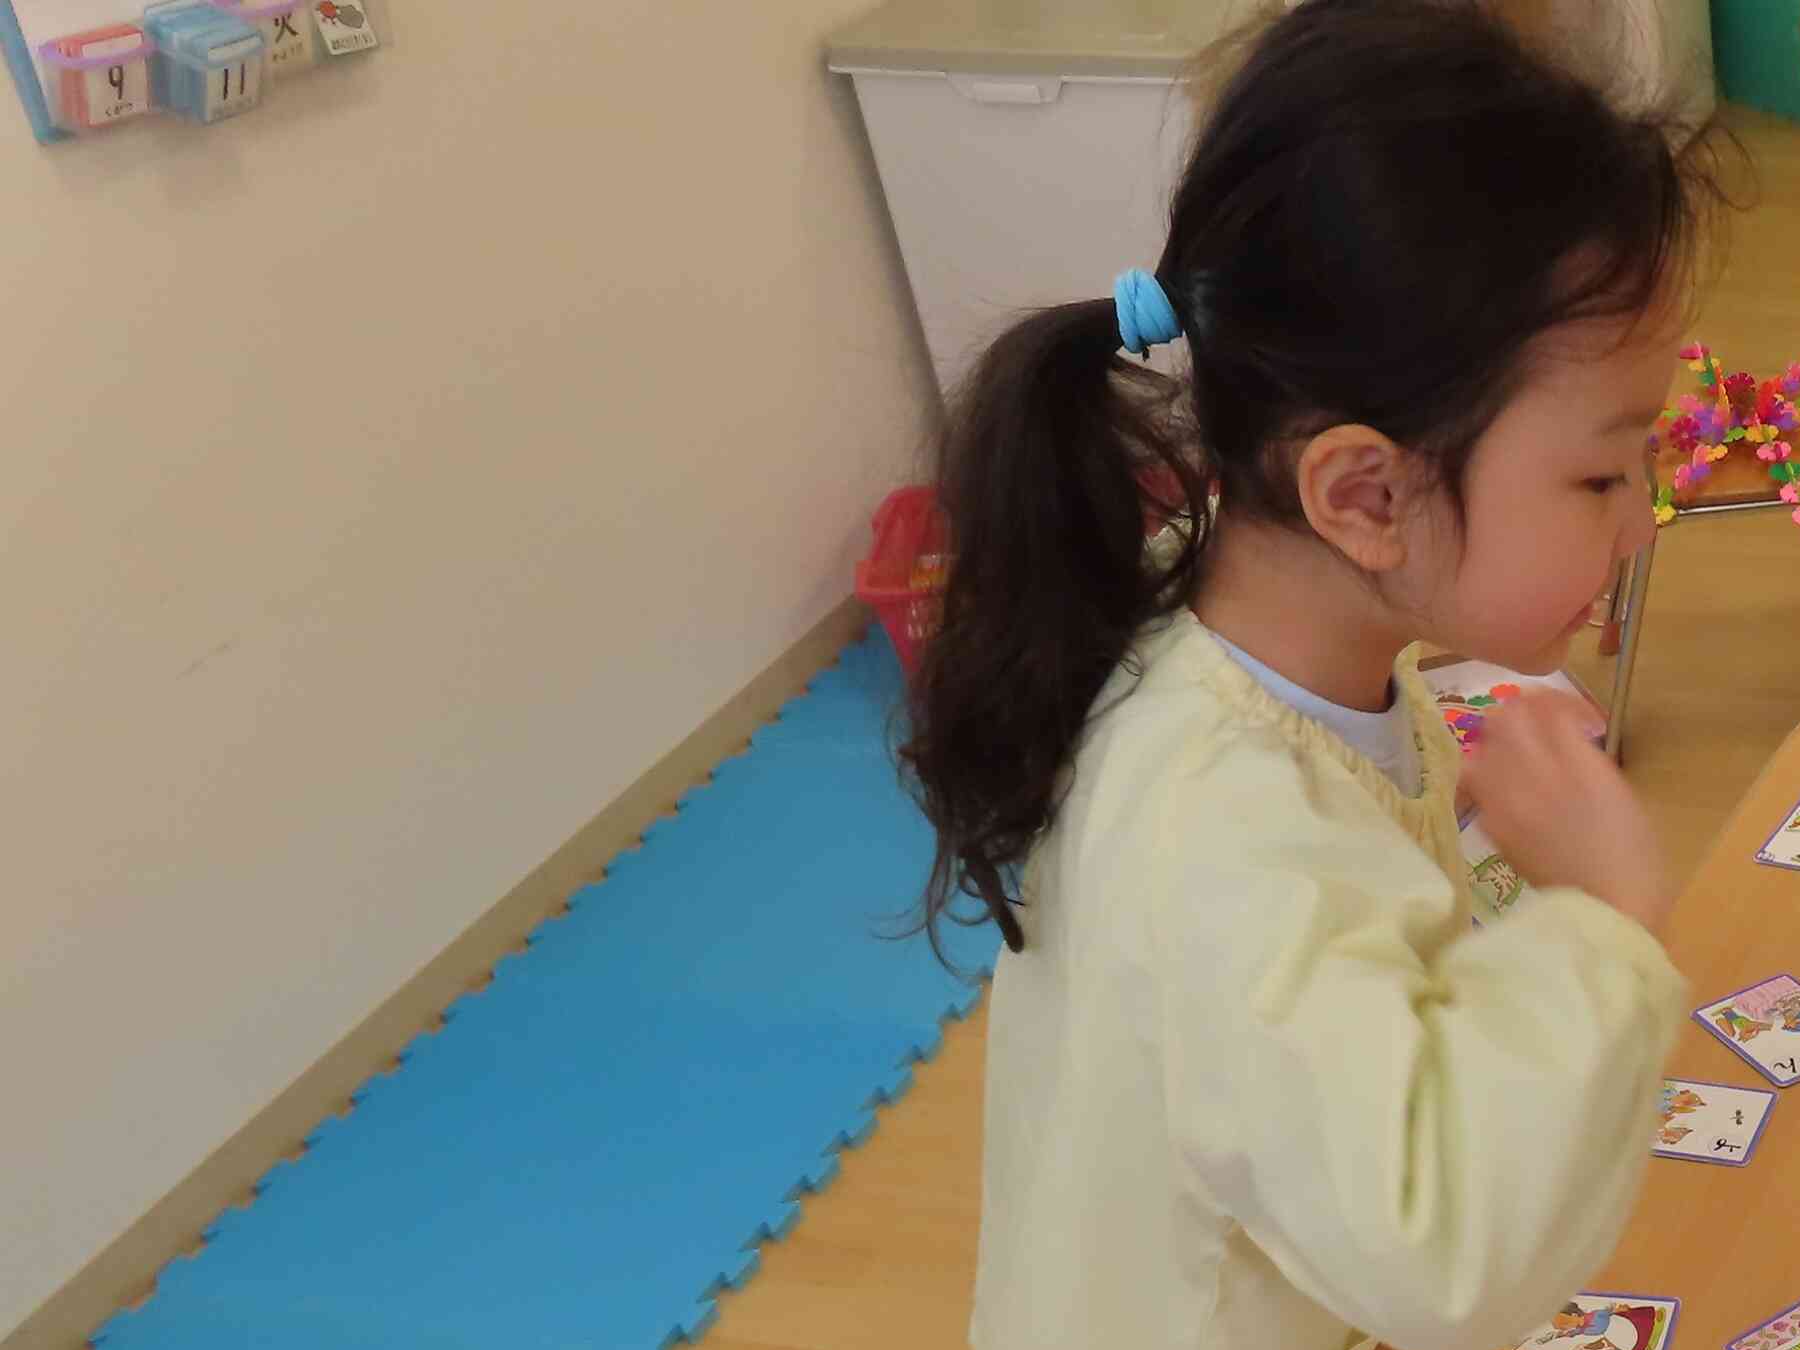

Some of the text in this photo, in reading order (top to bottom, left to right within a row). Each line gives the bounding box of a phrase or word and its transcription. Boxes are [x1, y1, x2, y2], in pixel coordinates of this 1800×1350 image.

[275, 13, 298, 42] 火
[109, 66, 123, 99] 9
[224, 64, 244, 100] 11
[1773, 1058, 1798, 1074] ん
